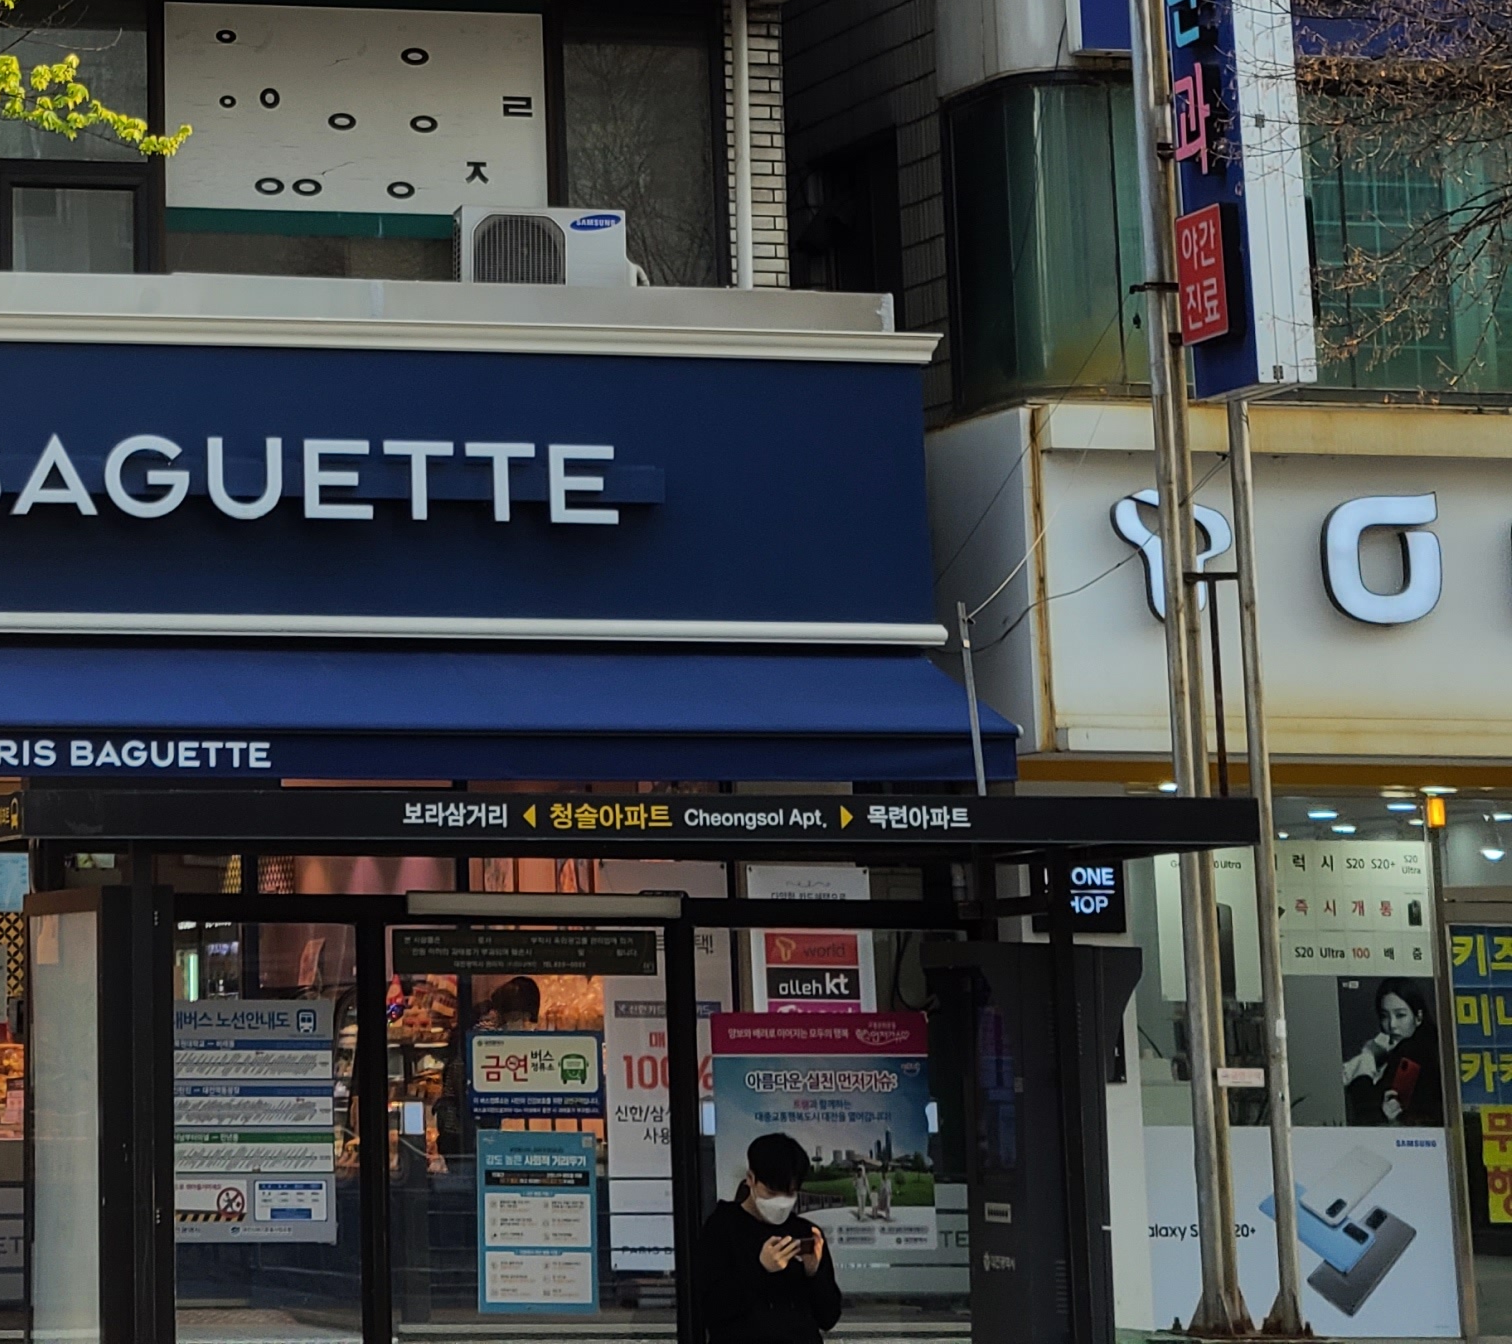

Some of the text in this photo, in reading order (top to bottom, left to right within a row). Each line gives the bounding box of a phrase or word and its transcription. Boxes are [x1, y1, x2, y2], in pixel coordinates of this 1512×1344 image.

[574, 217, 618, 231] SAMSUNG
[1180, 219, 1218, 275] 야간
[1184, 277, 1221, 329] 진료
[70, 739, 273, 770] BAGUETTE
[402, 803, 973, 831] 보라삼거리 청솔아파트 Cheongsol Apt. 목련아파트
[1345, 859, 1365, 870] S20
[1370, 859, 1396, 871] S20+
[1403, 854, 1419, 864] S20
[1401, 865, 1422, 875] Ultra
[802, 942, 847, 958] world
[1294, 946, 1314, 959] S20
[1319, 946, 1346, 960] Ultra
[1351, 947, 1371, 960] 100
[778, 972, 850, 996] olleh kt
[216, 1010, 292, 1030] 노선안내도
[530, 1049, 556, 1063] 버스
[480, 1054, 529, 1083] 금연
[530, 1062, 556, 1072] 정류소
[745, 1070, 803, 1092] 아름다운
[806, 1071, 834, 1092] 실천
[1395, 1139, 1437, 1149] SAMSUNG
[523, 1155, 551, 1167] 사회적
[551, 1155, 588, 1167] 거리두기
[1149, 1224, 1187, 1242] alaxy
